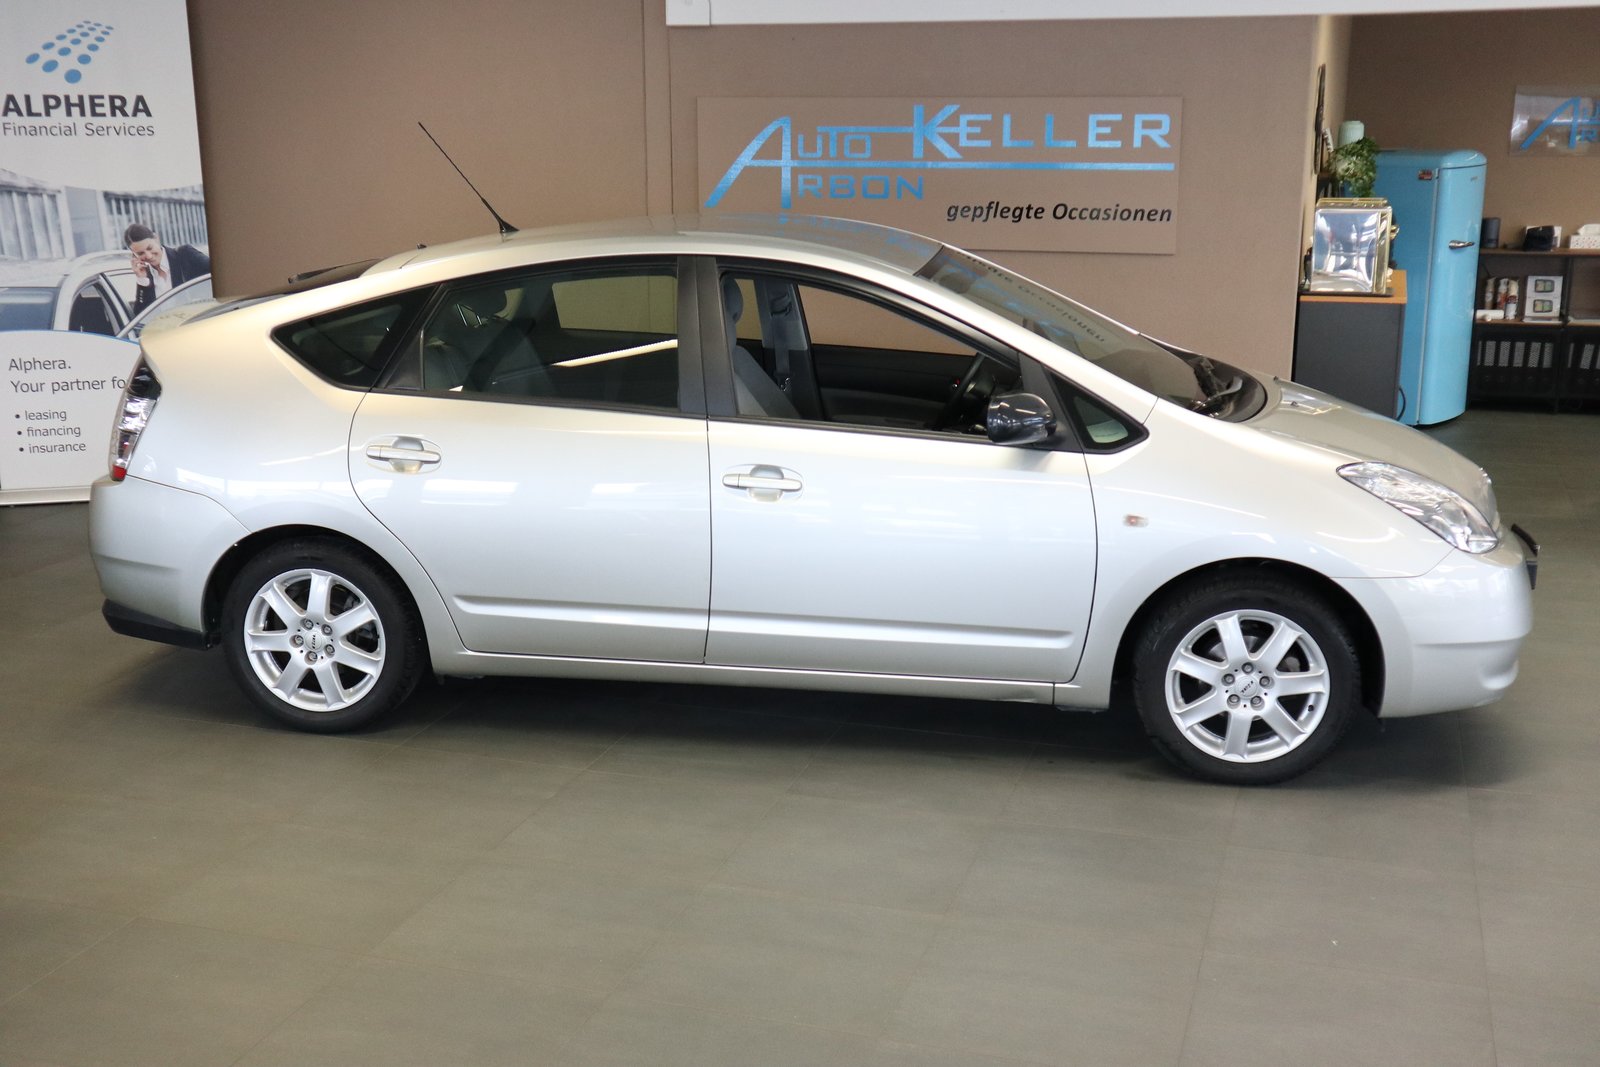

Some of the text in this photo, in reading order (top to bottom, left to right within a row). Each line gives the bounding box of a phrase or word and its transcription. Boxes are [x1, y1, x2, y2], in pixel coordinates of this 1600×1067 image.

[1, 94, 153, 118] ALPHERA
[3, 122, 155, 137] Financial Services
[912, 104, 1172, 159] KELLER
[947, 201, 1172, 223] gepflegte Occasionen
[8, 358, 72, 374] Alphera.
[10, 375, 126, 395] Your partner fo
[25, 410, 67, 422] leasing
[27, 426, 81, 438] financing
[29, 442, 87, 454] insurance
